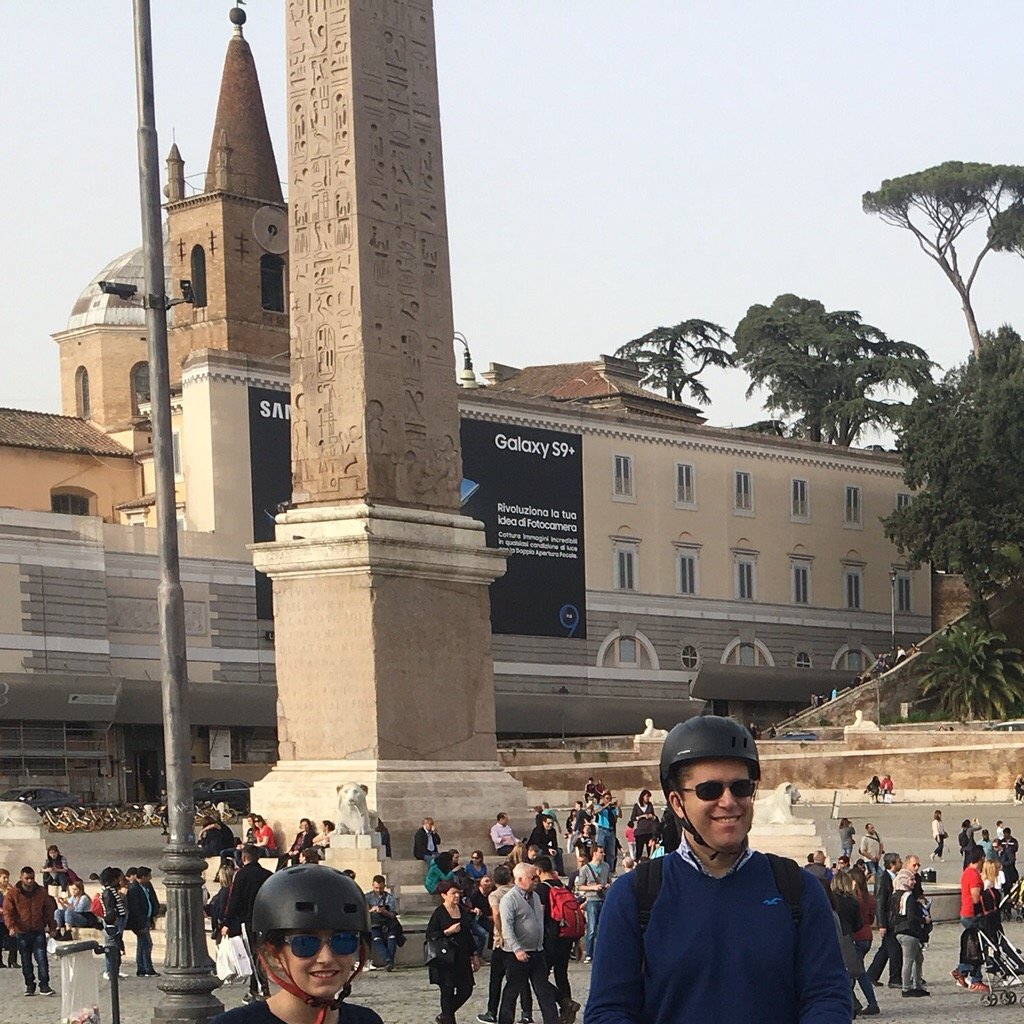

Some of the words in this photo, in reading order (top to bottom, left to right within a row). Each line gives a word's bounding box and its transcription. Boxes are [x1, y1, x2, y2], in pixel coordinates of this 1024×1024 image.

[495, 434, 549, 459] Galaxy
[552, 441, 575, 458] S9+
[497, 503, 549, 517] Rivoluziona
[551, 509, 560, 518] la
[562, 510, 577, 520] tua
[498, 515, 517, 526] idea
[518, 518, 526, 527] di
[527, 519, 577, 532] Fotocamera
